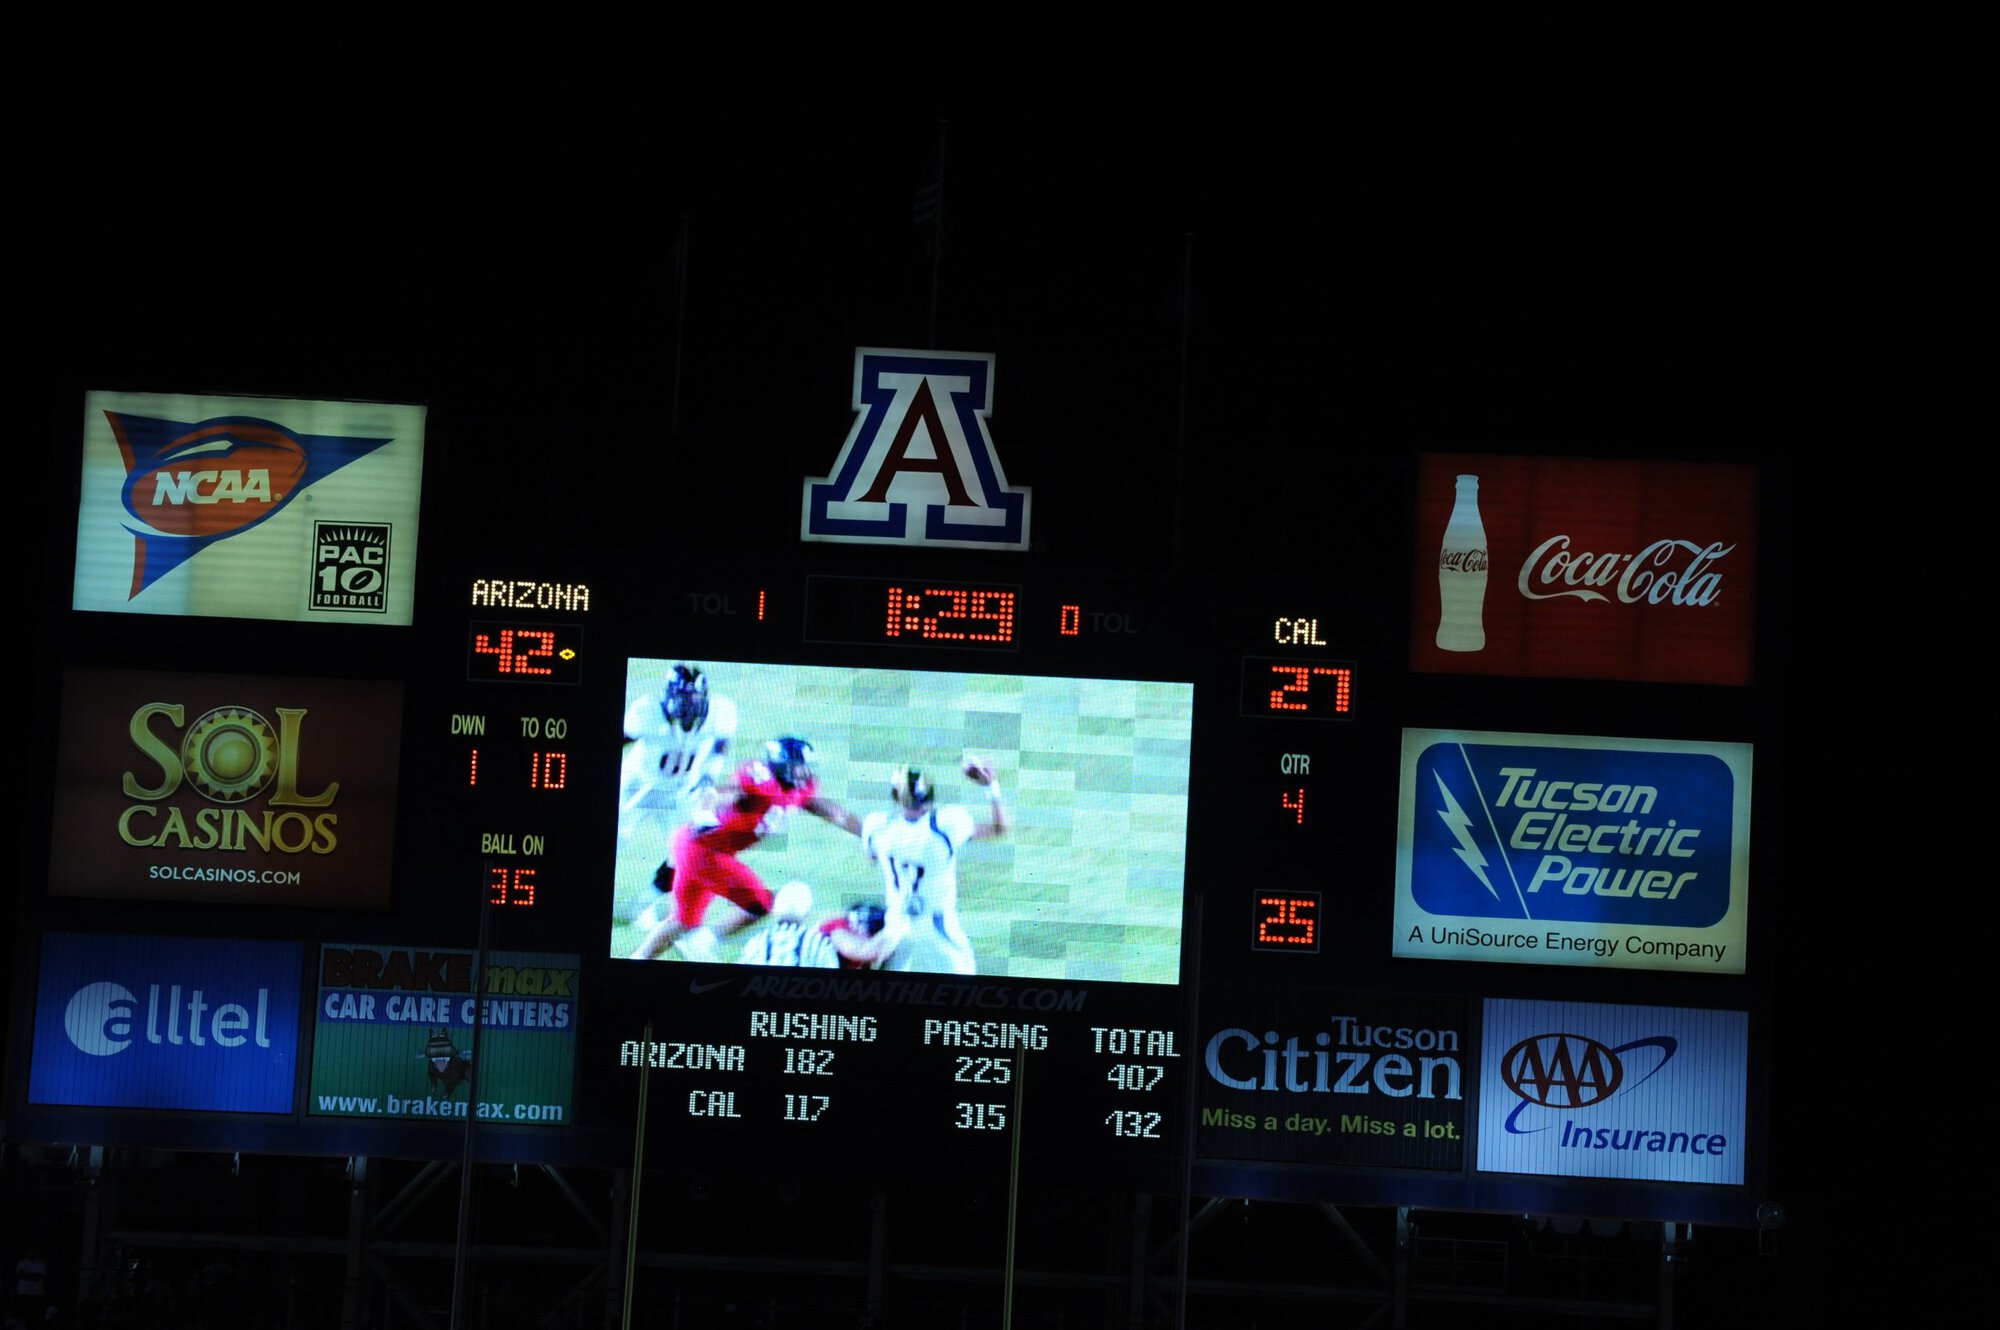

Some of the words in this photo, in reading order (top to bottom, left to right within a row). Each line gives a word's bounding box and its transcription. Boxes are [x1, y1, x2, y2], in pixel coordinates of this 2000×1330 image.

[152, 468, 271, 506] NCAA
[319, 545, 383, 566] PAC
[1517, 534, 1737, 606] Coca-Cola
[318, 566, 382, 593] 10
[472, 579, 590, 611] ARIZONA
[316, 594, 381, 608] FOOTBALL
[688, 592, 737, 615] TOL
[756, 588, 766, 622] 1
[886, 586, 1015, 642] 1:29
[1060, 603, 1081, 636] 0
[1089, 612, 1138, 634] TOL
[1274, 617, 1328, 646] CAL
[474, 629, 555, 675] 42
[1269, 665, 1351, 713] 27
[450, 714, 486, 736] DWN
[520, 716, 540, 738] TO
[545, 717, 568, 740] GO
[122, 701, 340, 807] SOL
[469, 749, 478, 787] 1
[530, 751, 567, 790] 10
[1280, 752, 1311, 775] QTR
[1282, 787, 1305, 825] 4
[1495, 766, 1658, 815] Tucson
[118, 805, 338, 854] CASINOS
[481, 832, 517, 855] BALL
[522, 834, 545, 856] ON
[1509, 811, 1701, 858] Electric
[149, 865, 301, 885] SOLCASINOS.COM
[489, 868, 536, 906] 35
[1526, 855, 1699, 900] Power
[1258, 898, 1316, 945] 25
[1408, 926, 1424, 943] A
[1430, 926, 1538, 949] UniSource
[1546, 932, 1619, 957] Energy
[1626, 936, 1726, 962] Company
[324, 993, 376, 1020] CAR
[386, 995, 450, 1023] CARE
[461, 999, 569, 1029] CENTERS
[739, 974, 1088, 1012] ARIZONAATHLETICS.COM
[100, 981, 271, 1050] alltel
[750, 1010, 877, 1042] RUSHING
[923, 1018, 1049, 1050] PASSING
[1090, 1027, 1181, 1057] TOTAL
[1331, 1015, 1459, 1051] Tucson
[620, 1040, 746, 1072] ARIZONA
[783, 1047, 835, 1076] 182
[954, 1056, 1012, 1085] 225
[1107, 1063, 1165, 1092] 407
[1204, 1027, 1463, 1100] Citizen
[1510, 1034, 1614, 1107] AAA
[688, 1089, 742, 1119] CAL
[783, 1093, 830, 1121] 117
[955, 1102, 1007, 1131] 315
[1201, 1107, 1257, 1130] Miss
[1263, 1115, 1278, 1131] a
[1285, 1113, 1332, 1136] day.
[1340, 1114, 1396, 1136] Miss
[1403, 1122, 1418, 1138] a
[1424, 1120, 1461, 1140] lot.
[1561, 1120, 1727, 1155] Insurance
